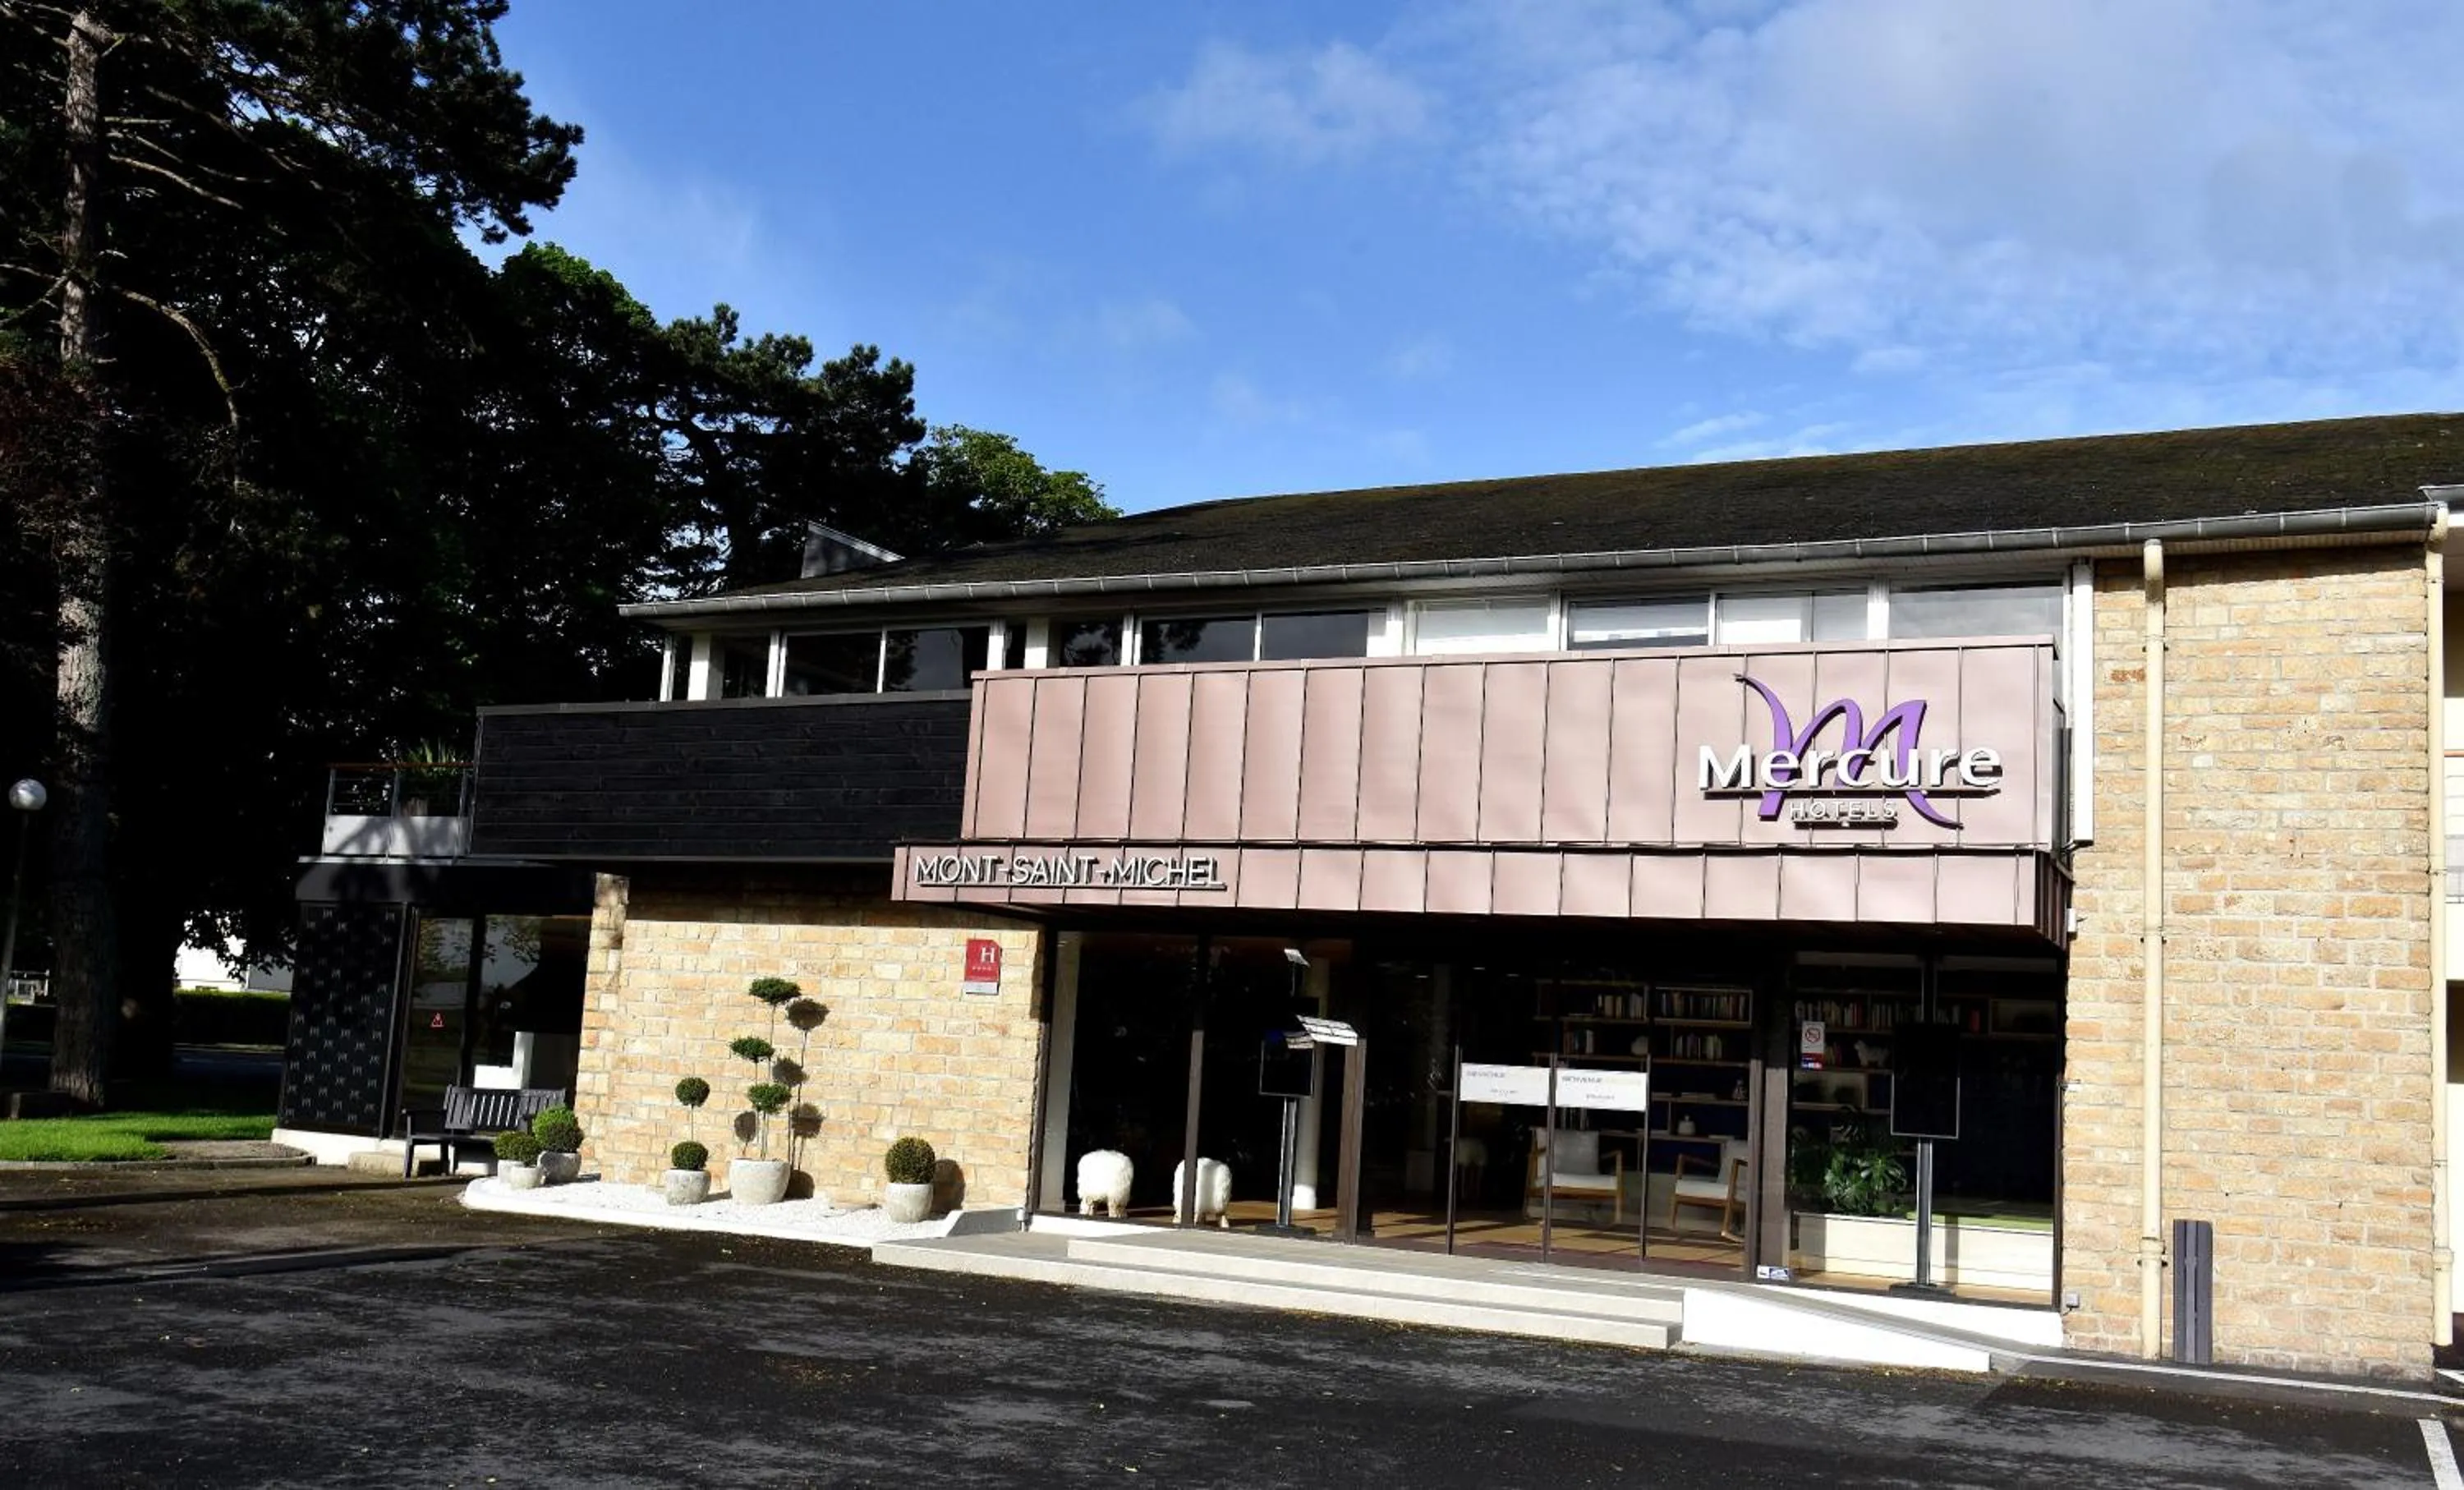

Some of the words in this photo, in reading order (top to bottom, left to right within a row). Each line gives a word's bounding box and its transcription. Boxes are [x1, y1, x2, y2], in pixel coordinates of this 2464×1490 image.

[1698, 743, 2002, 790] Mercure
[1790, 801, 1896, 819] HOTELS
[914, 854, 1225, 886] MONT-SAINT-MICHEL
[981, 946, 995, 963] H
